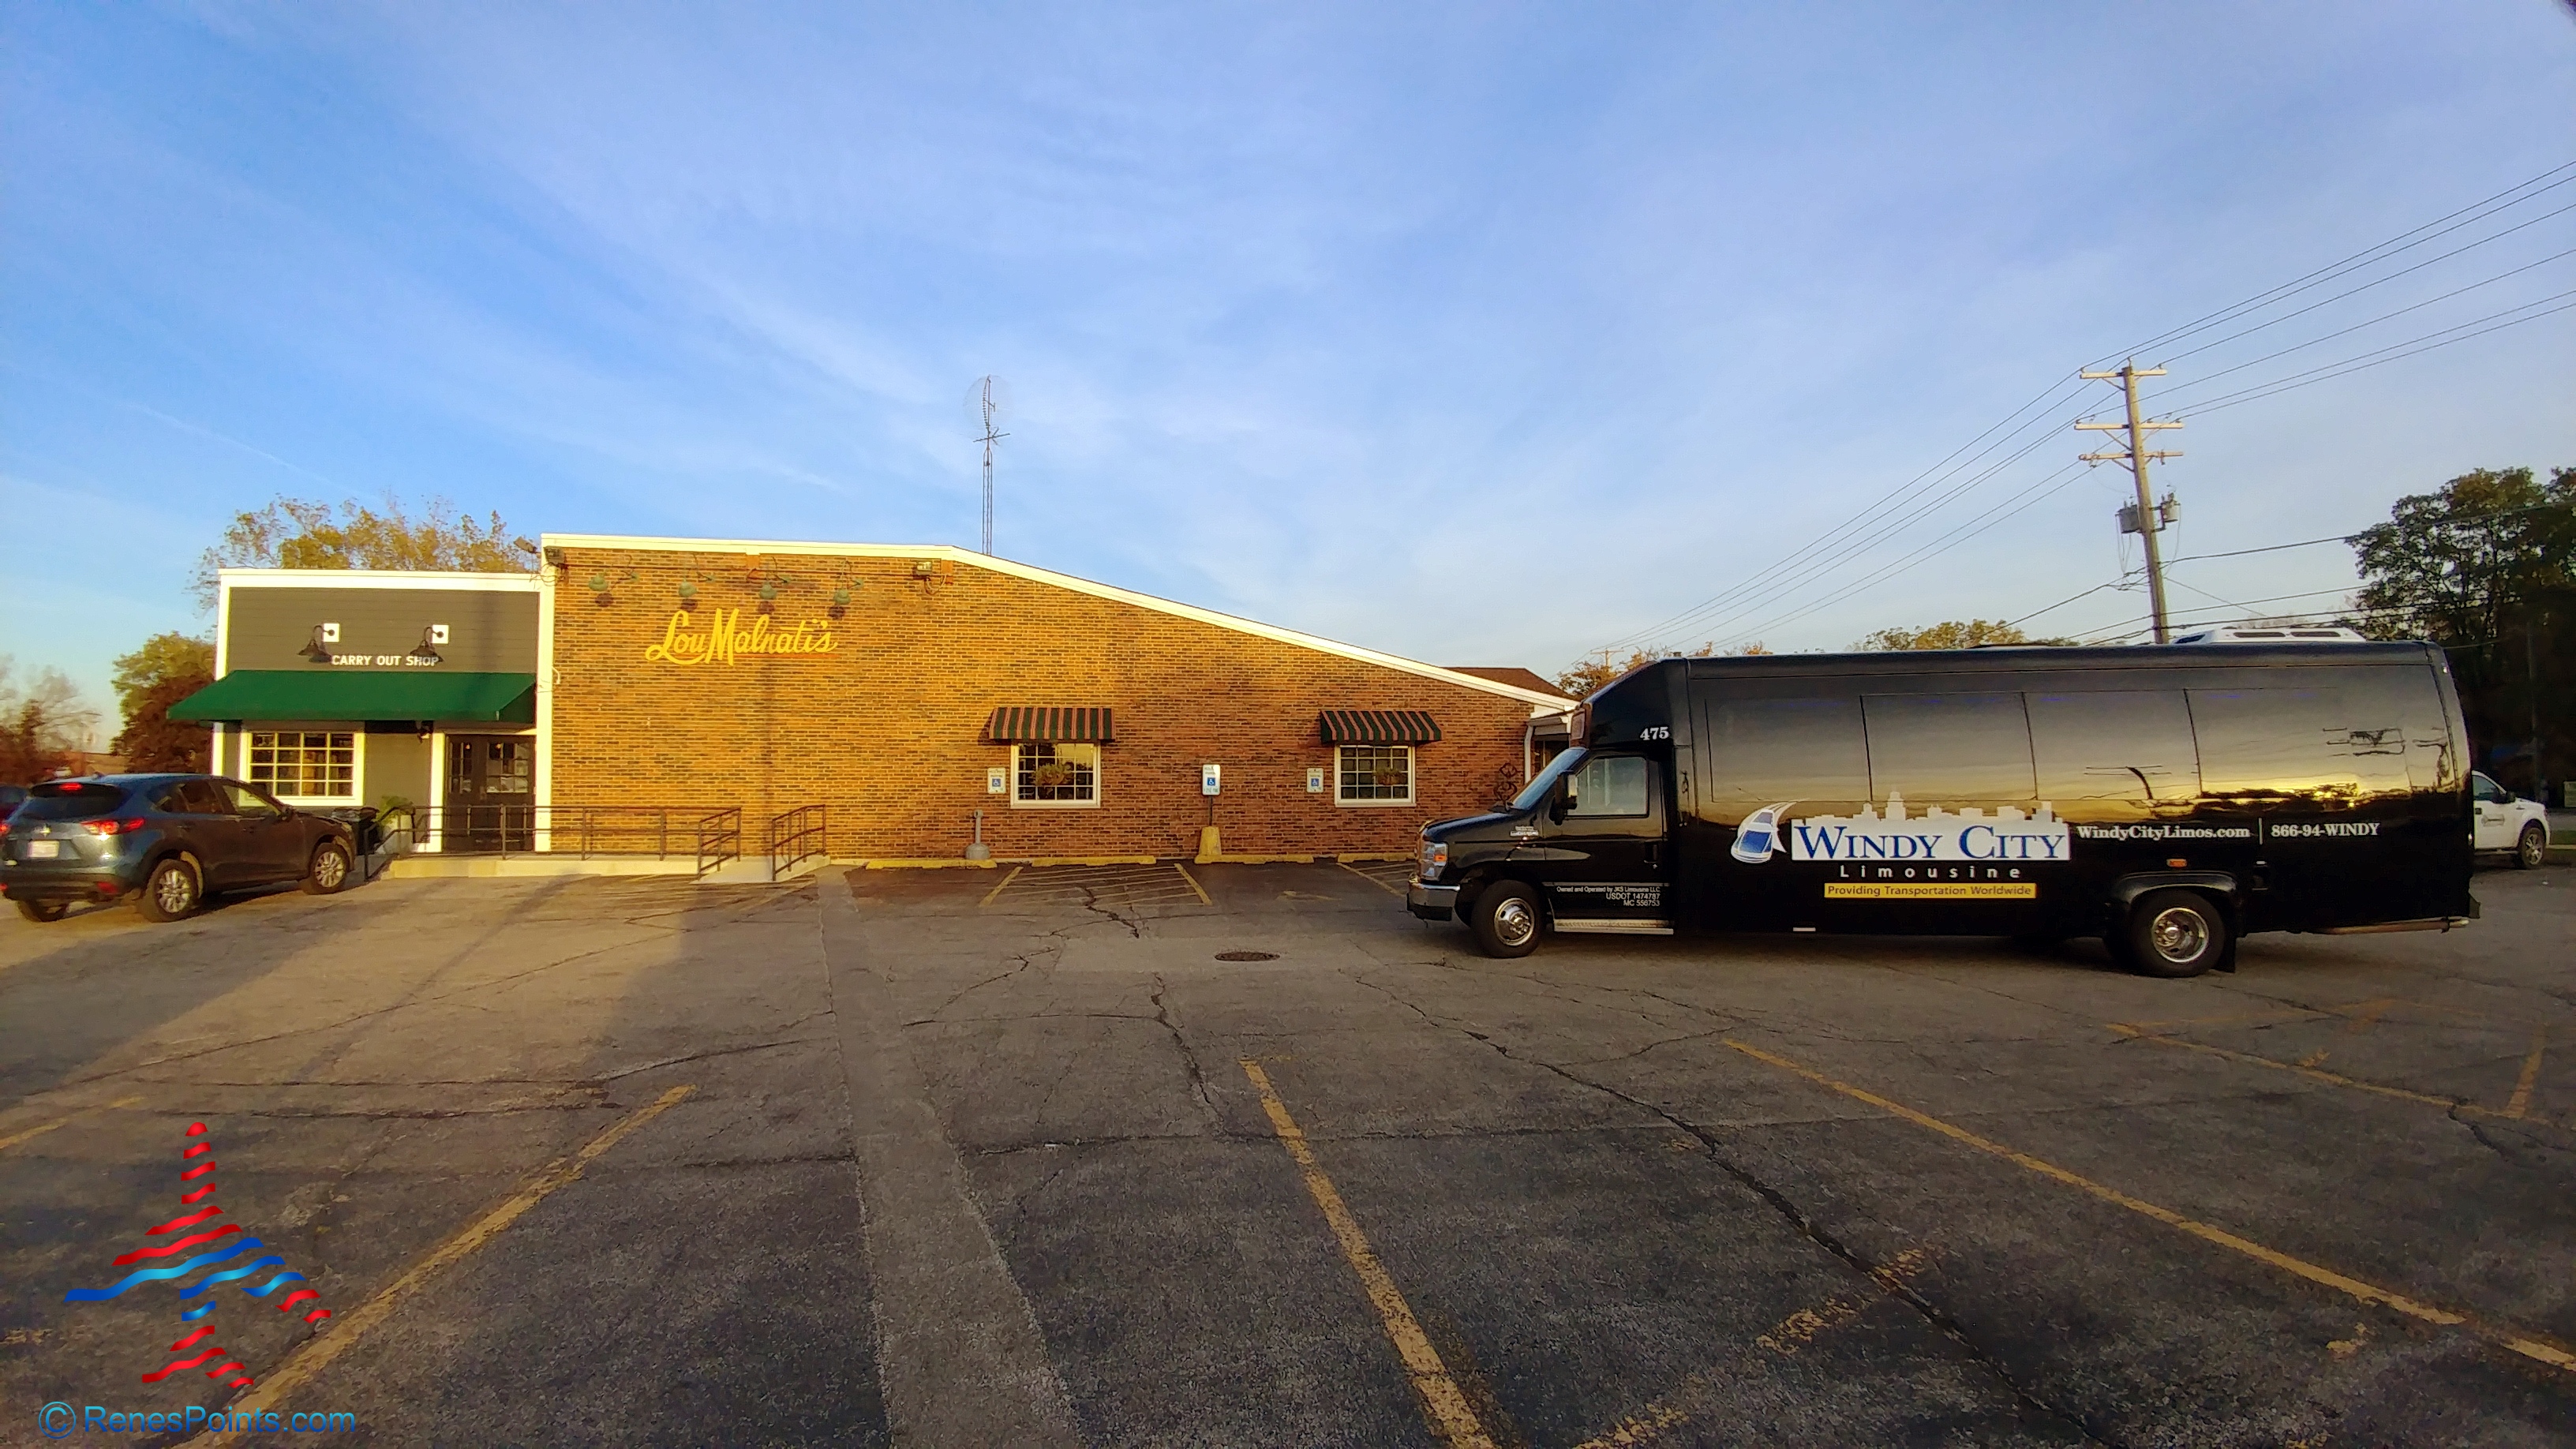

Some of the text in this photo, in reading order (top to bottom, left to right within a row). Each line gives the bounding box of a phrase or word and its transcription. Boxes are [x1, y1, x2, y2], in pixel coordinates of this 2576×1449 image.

[646, 608, 838, 666] Lou Malnati's
[331, 655, 439, 666] CARRY OUT SHOP
[1640, 726, 1669, 740] 475
[2076, 822, 2380, 841] WindyCityLimos.com 866-94-WINDY
[1840, 865, 2021, 878] Limousine
[1828, 886, 2031, 897] Providing Transportation Worldwide
